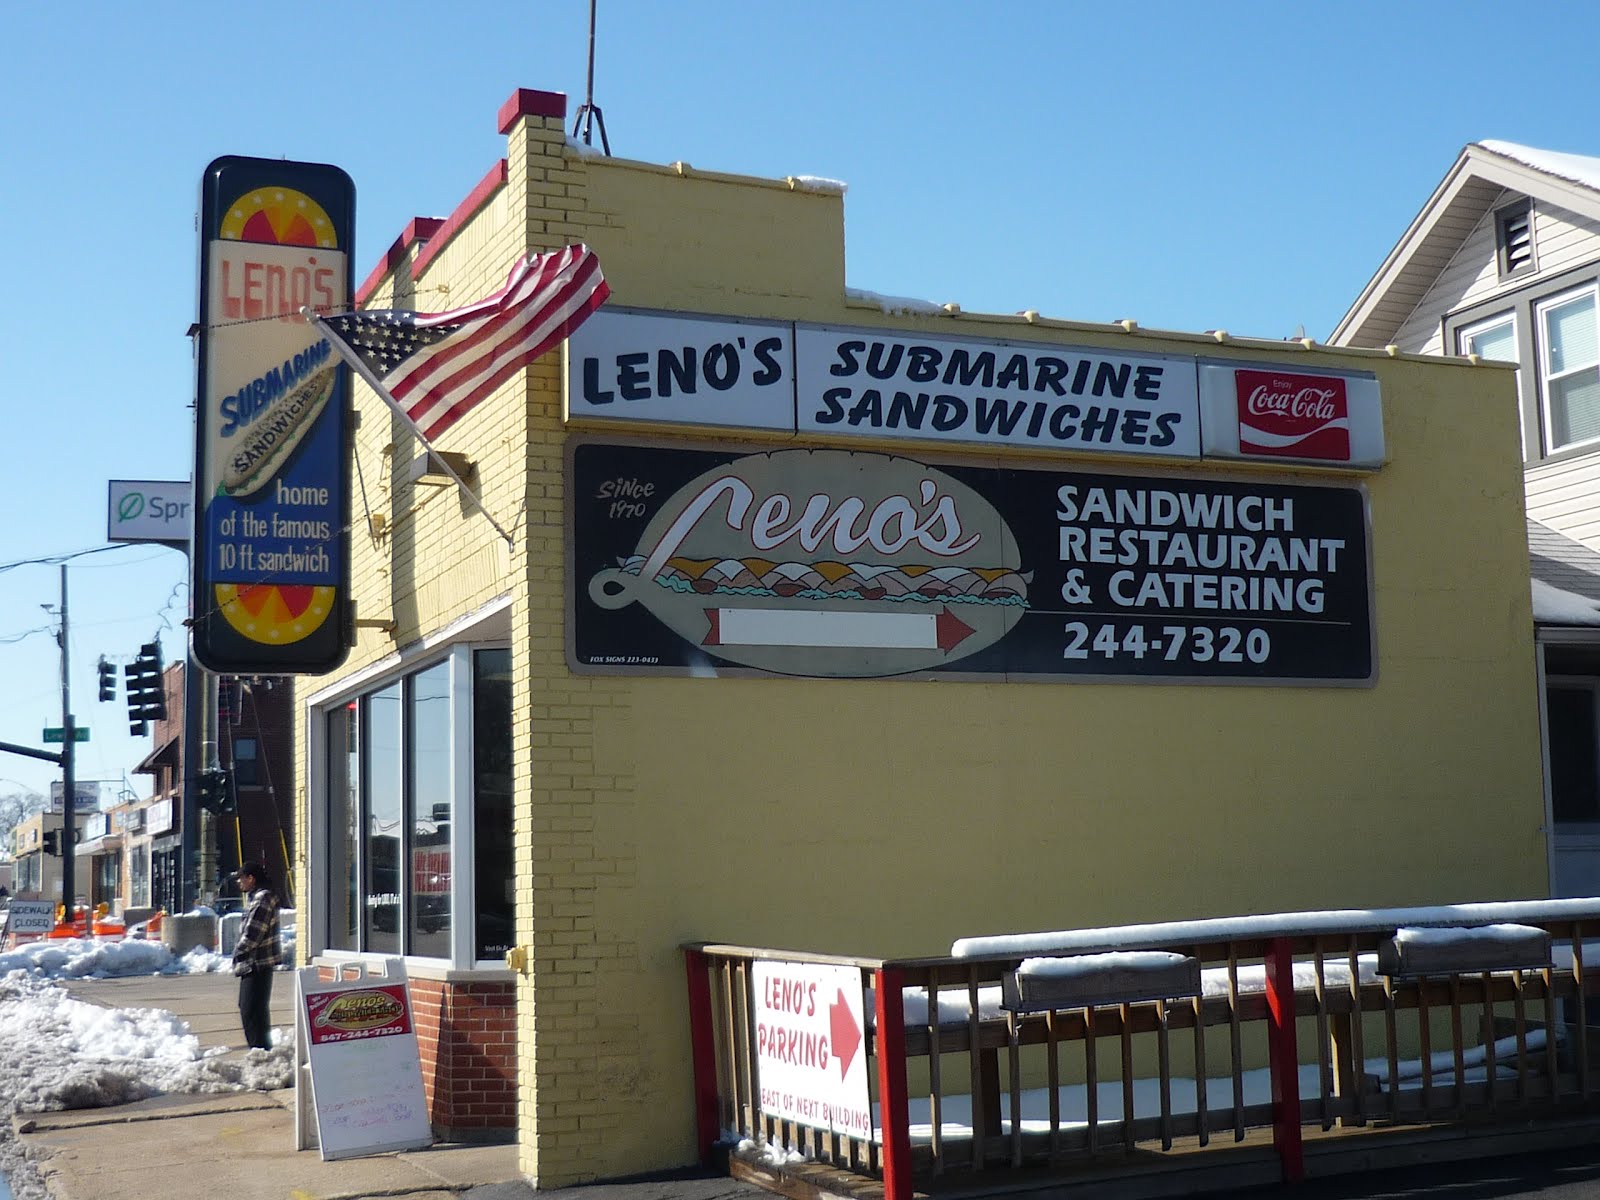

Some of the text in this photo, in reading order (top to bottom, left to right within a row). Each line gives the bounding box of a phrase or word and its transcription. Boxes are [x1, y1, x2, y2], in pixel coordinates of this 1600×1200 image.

[221, 257, 334, 323] LENO'S
[219, 338, 332, 438] SUBMARINE
[584, 337, 783, 405] LENO'S
[830, 341, 1164, 401] SUBMARINE
[1273, 379, 1292, 389] Enjoy
[815, 387, 1181, 448] SANDWICHES
[1248, 385, 1337, 419] Coca-Cola
[232, 382, 318, 474] SANDWICHES
[277, 478, 329, 506] home
[609, 500, 646, 518] 1970
[1056, 485, 1294, 531] SANDWICH
[220, 510, 330, 540] of the famous
[639, 475, 982, 582] Leno's
[219, 543, 236, 571] 10
[258, 546, 330, 573] sandwich
[1059, 526, 1345, 573] RESTAURANT
[1061, 568, 1325, 614] & CATERING
[1063, 621, 1271, 664] 244-7320
[10, 906, 53, 915] SIDEWALK
[15, 918, 50, 928] CLOSED
[765, 975, 817, 1017] LENO'S
[758, 1023, 828, 1070] PARKING
[761, 1087, 869, 1131] EAST OF NEXT BUILDING
